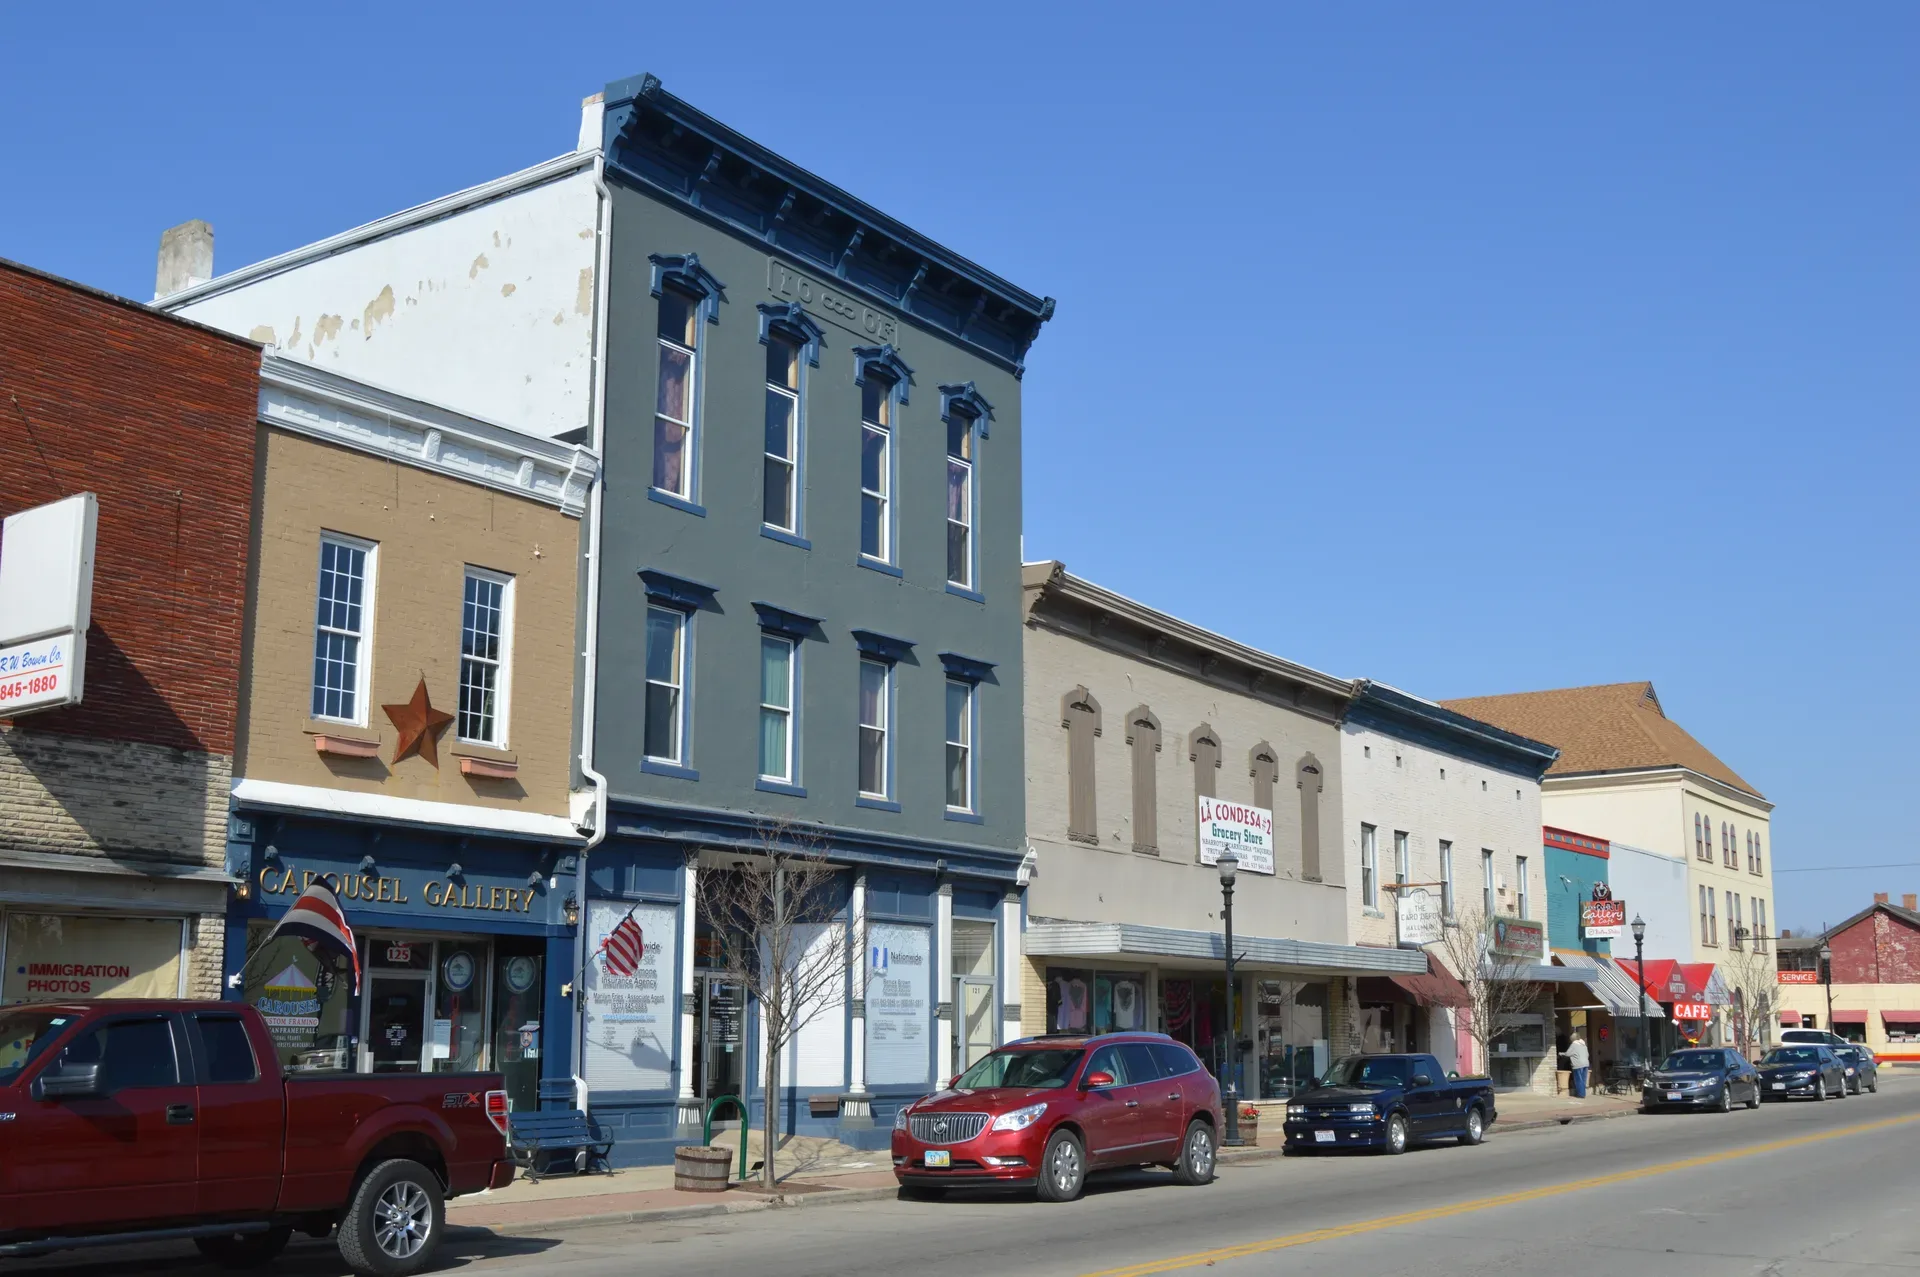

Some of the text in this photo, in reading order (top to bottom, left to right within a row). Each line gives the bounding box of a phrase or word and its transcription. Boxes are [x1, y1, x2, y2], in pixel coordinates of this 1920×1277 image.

[22, 652, 47, 667] Bowen
[50, 645, 61, 663] Co.
[0, 675, 57, 700] 845-1880
[1216, 804, 1261, 829] CONDESA
[1212, 823, 1263, 845] Grocery Store
[260, 865, 535, 913] CAROUSEL GALLERY
[1415, 904, 1426, 912] THE
[1595, 902, 1620, 910] ART
[1401, 913, 1418, 921] CARD
[1582, 909, 1623, 921] Gallery
[388, 949, 409, 960] 125
[891, 952, 922, 961] Nationwide
[29, 963, 130, 978] IMMIGRATION
[1781, 973, 1813, 981] SERVICE
[28, 980, 91, 993] PHOTOS
[602, 977, 657, 988] Insurance Agency
[258, 997, 320, 1015] CAROUSEL
[1675, 1004, 1709, 1018] CAFE
[265, 1017, 317, 1025] USTOM FRAMING
[443, 1092, 480, 1106] STX
